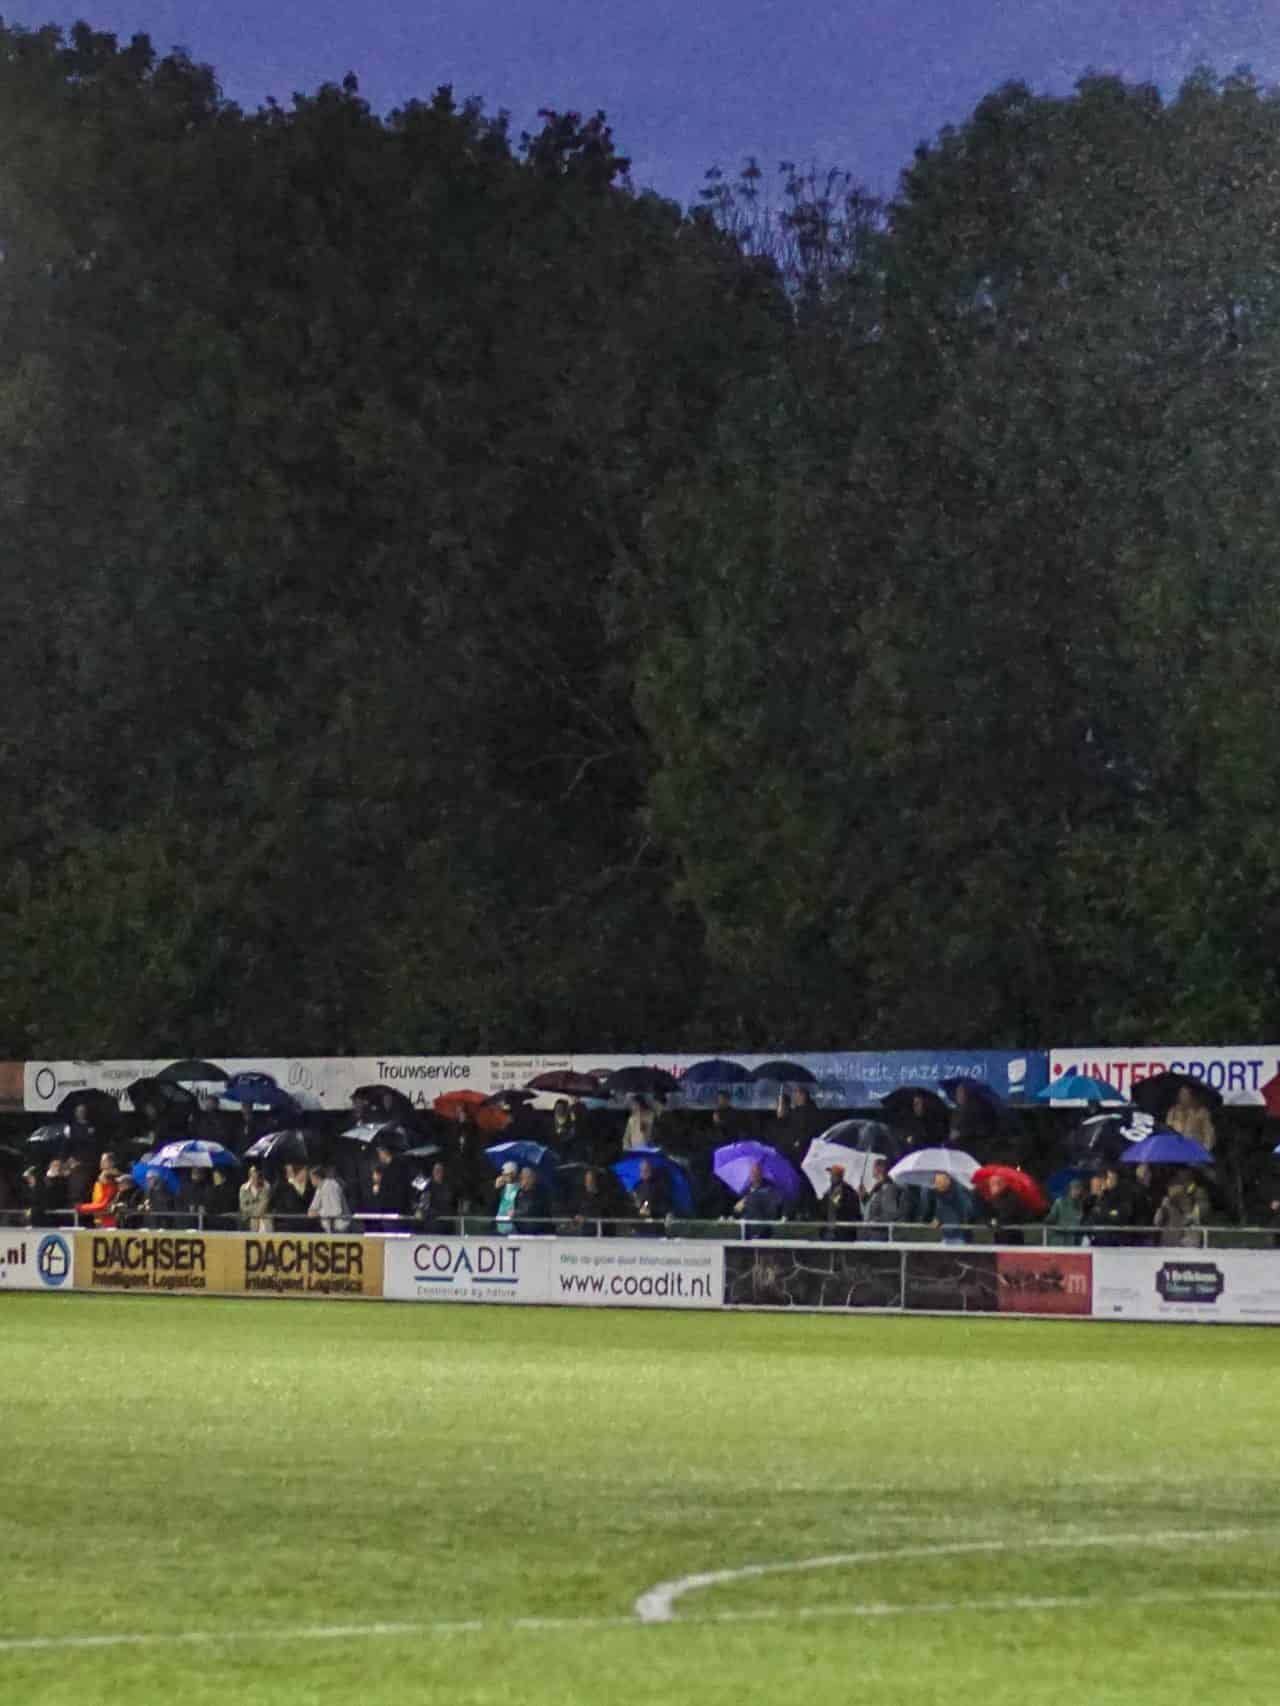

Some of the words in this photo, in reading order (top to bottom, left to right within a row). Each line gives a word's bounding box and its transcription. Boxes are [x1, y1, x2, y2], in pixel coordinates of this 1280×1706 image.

[376, 1061, 471, 1079] Trouwservice
[93, 1236, 206, 1271] DACHSER
[245, 1239, 364, 1275] DACHSER
[414, 1243, 521, 1274] COADIT
[560, 1272, 712, 1297] www.coadit.nl
